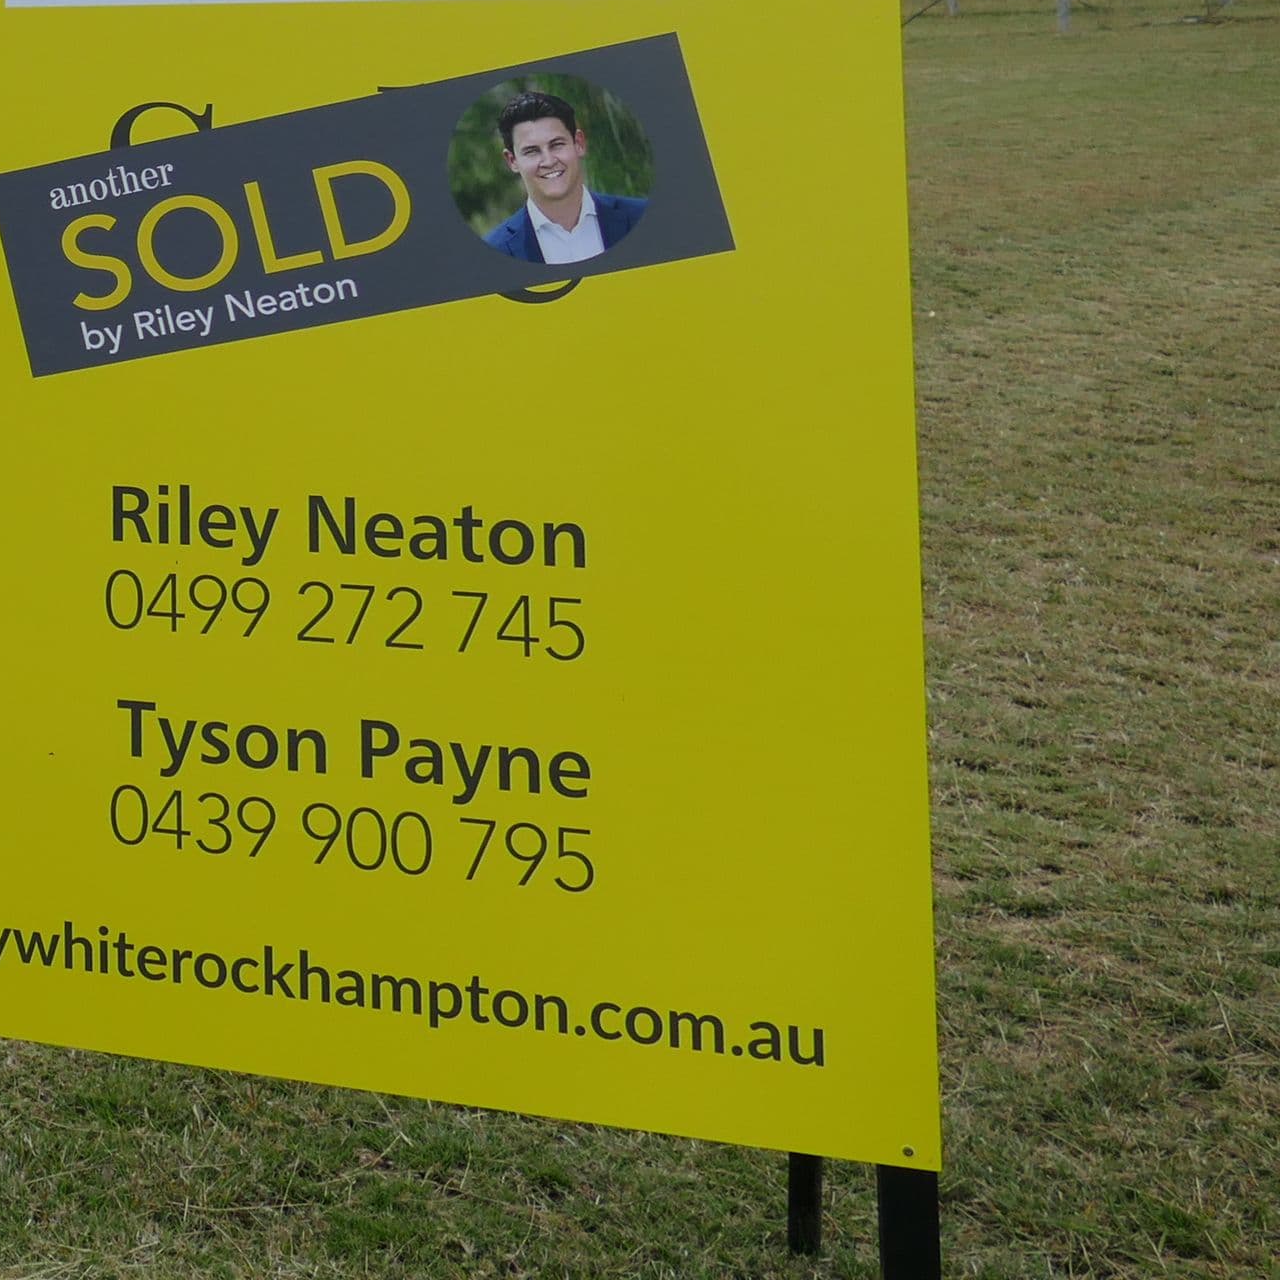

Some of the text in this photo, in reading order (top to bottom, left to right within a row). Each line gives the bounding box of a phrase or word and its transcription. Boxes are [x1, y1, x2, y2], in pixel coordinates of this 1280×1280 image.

[50, 164, 173, 209] another
[61, 159, 412, 310] SOLD
[81, 279, 357, 354] by Riley Neaton
[113, 485, 585, 568] Riley Neaton
[106, 570, 584, 661] 0499 272 745
[117, 699, 591, 804] Tyson Payne
[111, 785, 594, 892] 0439 900 795
